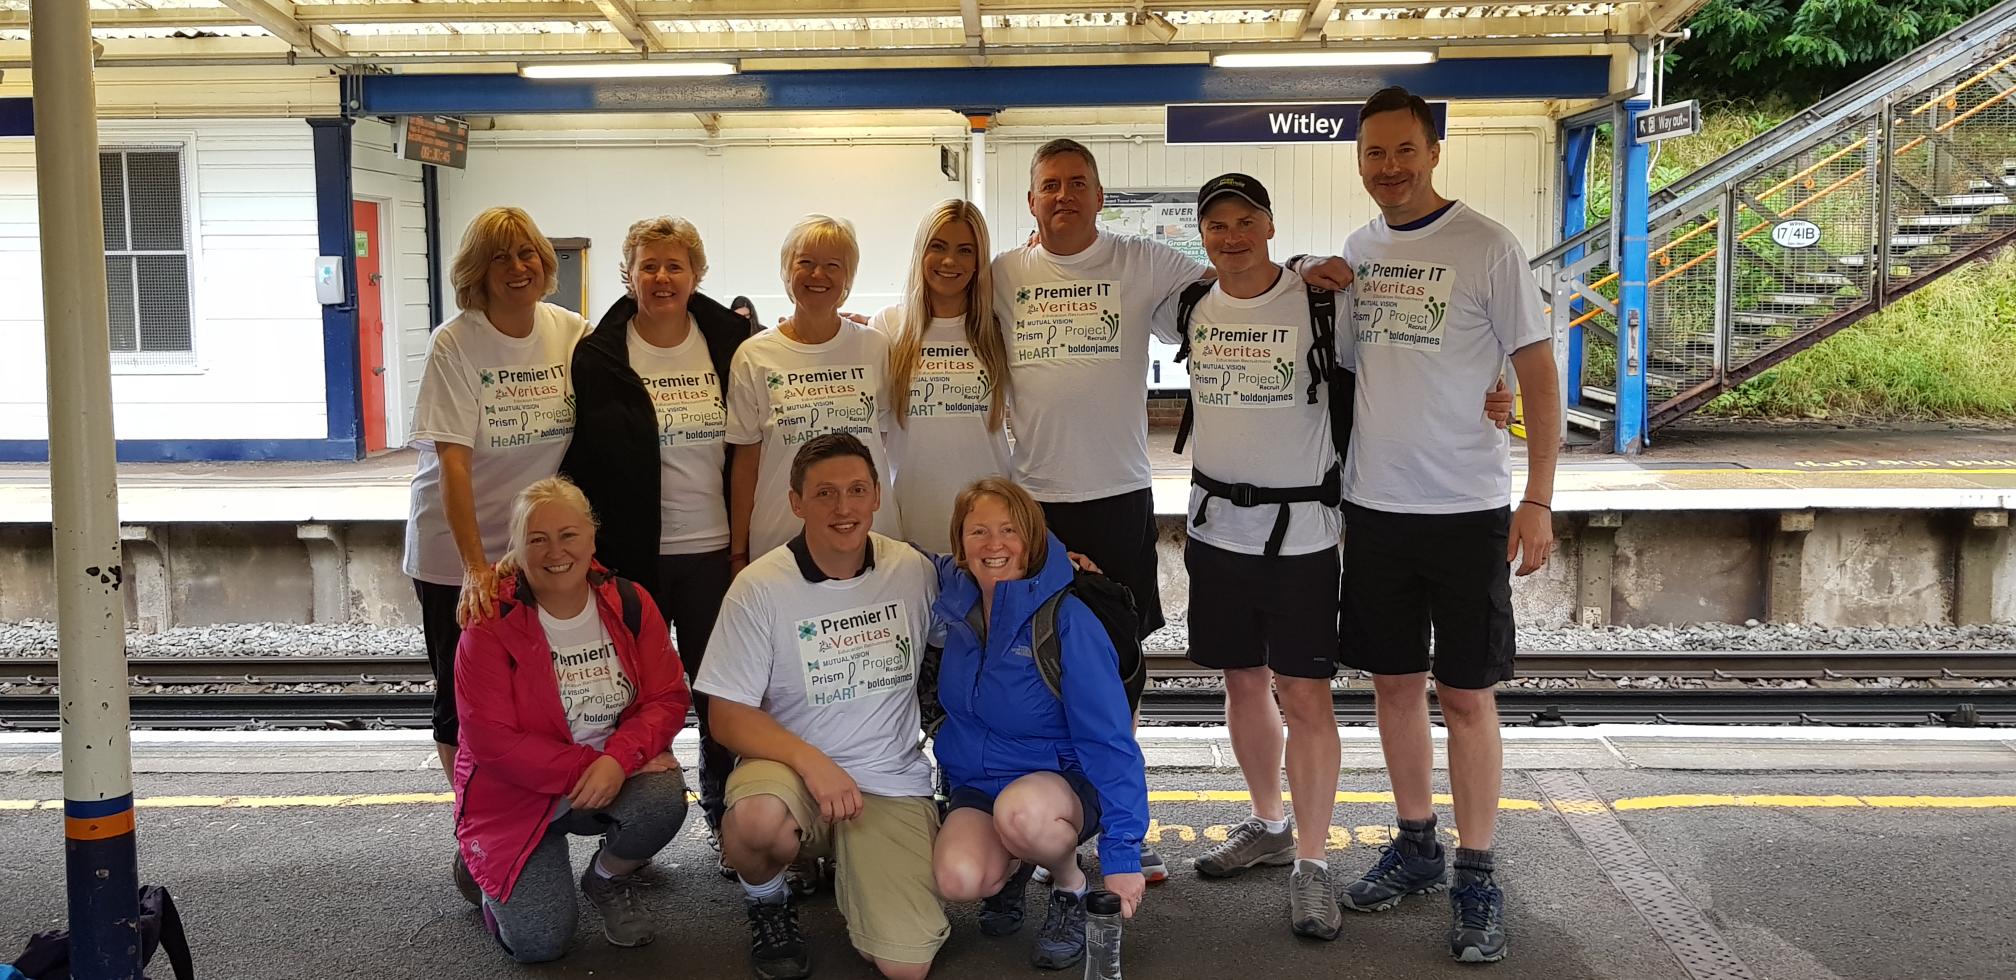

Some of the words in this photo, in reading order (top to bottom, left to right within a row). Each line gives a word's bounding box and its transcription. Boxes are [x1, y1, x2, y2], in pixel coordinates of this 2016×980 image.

[1268, 112, 1344, 139] Witley
[1658, 115, 1672, 131] Way
[1672, 112, 1684, 127] out
[1161, 208, 1193, 216] NEVER
[1371, 263, 1426, 280] Premier
[1428, 267, 1446, 282] IT
[1034, 283, 1093, 300] Premier
[1097, 283, 1111, 297] IT
[1372, 280, 1425, 296] Veritas
[1038, 300, 1097, 313] Veritas
[1389, 309, 1428, 325] Project
[1065, 325, 1107, 338] Project
[1407, 323, 1427, 331] Recruit
[1016, 331, 1043, 342] Prism
[1209, 327, 1268, 342] Premier
[1272, 329, 1289, 343] IT
[1388, 330, 1440, 345] boldonjames
[921, 345, 970, 357] remier
[1018, 346, 1058, 361] HeART
[1067, 344, 1119, 354] boldonjames
[1212, 344, 1271, 358] Veritas
[498, 368, 549, 384] Premier
[550, 364, 564, 379] IT
[704, 372, 716, 386] IT
[787, 368, 848, 386] Premier
[851, 367, 865, 380] IT
[1195, 373, 1218, 385] Prism
[1238, 372, 1280, 386] Project
[505, 384, 559, 398] Veritas
[650, 389, 709, 402] Veritas
[794, 384, 856, 397] Veritas
[942, 383, 981, 396] Project
[1198, 391, 1232, 405] HeART
[1240, 392, 1293, 404] boldonjames
[786, 402, 812, 411] MUTUAL
[812, 400, 834, 408] VISION
[826, 406, 866, 419] Project
[534, 407, 572, 421] Project
[681, 410, 722, 423] Project
[488, 417, 518, 428] Prism
[777, 416, 807, 428] Prism
[491, 432, 533, 448] HeART
[685, 428, 726, 439] boldonjam
[820, 610, 882, 634] Premier
[884, 603, 898, 620] IT
[829, 627, 891, 649] Veritas
[822, 655, 850, 667] MUTUAL
[850, 650, 870, 661] VISION
[862, 653, 902, 671] Project
[556, 664, 611, 682] Veritas
[811, 671, 844, 686] Prism
[567, 687, 590, 696] VISION
[814, 684, 858, 705] HeART
[867, 672, 913, 689] boldonjames
[582, 690, 625, 706] Project
